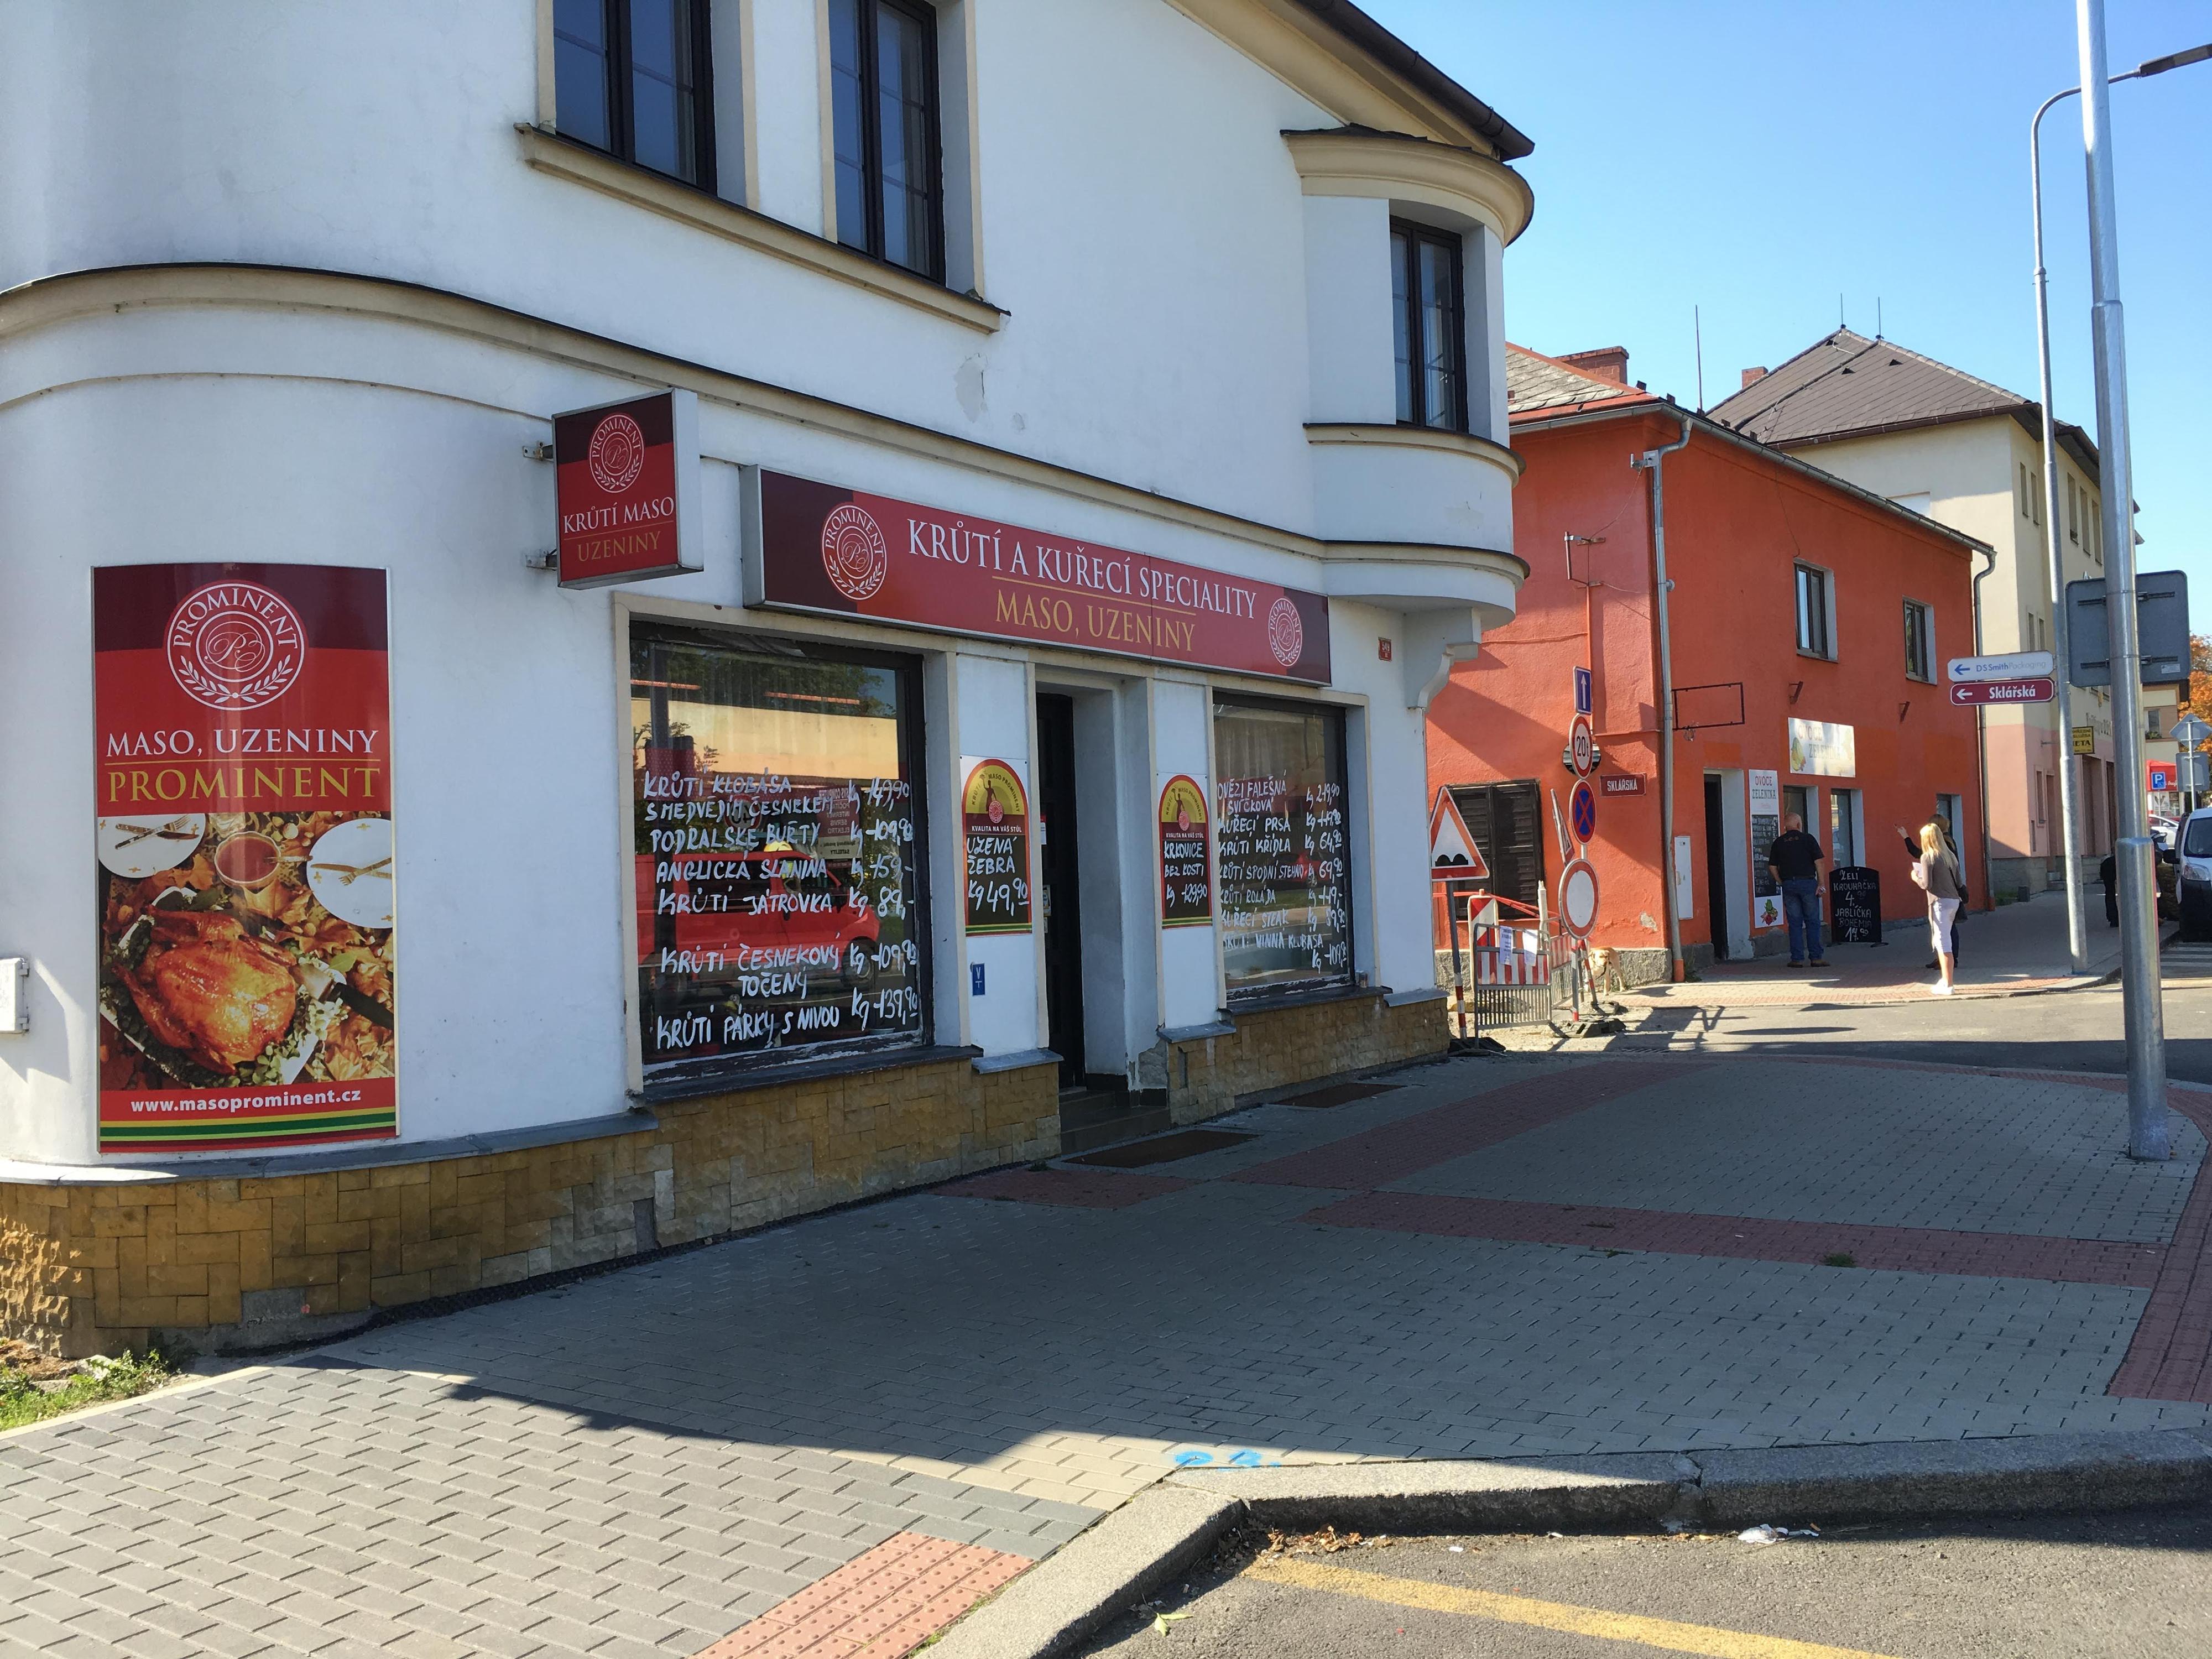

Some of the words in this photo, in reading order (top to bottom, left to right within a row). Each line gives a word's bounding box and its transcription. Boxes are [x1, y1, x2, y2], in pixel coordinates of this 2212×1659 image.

[592, 418, 641, 457] PROMINENT
[563, 502, 618, 533] KRŮTÍ
[624, 497, 674, 524] MASO
[577, 531, 661, 561] UZENINY
[826, 509, 884, 557] PROMINENT
[907, 520, 1001, 571] KRŮTÍ
[1009, 541, 1030, 576] A
[1036, 545, 1132, 594] KUŘECÍ
[1140, 567, 1256, 619] SPECIALITY
[173, 588, 298, 649] PROMINENT
[996, 589, 1079, 638] MASO,
[1088, 605, 1195, 651] UZENINY
[1270, 601, 1301, 635] PROMINENT
[1989, 685, 2036, 699] Sklářská
[107, 729, 202, 757] MASO,
[213, 729, 379, 753] UZENINY
[1798, 724, 1822, 741] OVOCE
[108, 767, 380, 802] PROMINENT
[644, 764, 707, 799] KRŮTÍ
[713, 767, 791, 794] KLOBÁSA
[1218, 774, 1245, 800] OVĚZÍ
[1607, 778, 1637, 791] SKLÁŘSKÁ
[1752, 789, 1776, 799] ZELENINA
[1755, 776, 1772, 786] OVOCE
[644, 802, 658, 821] S
[749, 796, 833, 817] ČESNEKEM
[1265, 816, 1291, 832] PRSA
[967, 837, 1017, 855] UZENÁ
[1164, 841, 1204, 859] KRKOVICE
[1256, 833, 1291, 857] KŘÍDLA
[1319, 830, 1342, 853] 64,90
[656, 850, 751, 884] ANGLICKÁ
[759, 858, 828, 880] SLANINA
[967, 855, 1015, 875] ŽEBRA
[1165, 864, 1180, 878] BEZ
[1183, 864, 1204, 877] KOSTI
[1246, 860, 1278, 884] SPODNÍ
[1279, 864, 1304, 879] STEHNO
[1319, 857, 1343, 884] 69,90
[1840, 868, 1859, 880] ŽELÍ
[658, 885, 733, 915] KRŮTÍ
[743, 888, 832, 916] JÁTROVKA
[987, 877, 1030, 916] 49,90
[1246, 885, 1276, 905] ROLÁDA
[1262, 908, 1289, 928] STEAK
[1835, 905, 1871, 918] JABLÍČKA
[661, 943, 727, 973] KRŮTÍ
[738, 932, 839, 972] ČESNEKOVÝ
[738, 966, 807, 999] TOČENÝ
[657, 1004, 714, 1050] KRŮTÍ
[724, 1003, 774, 1048] PÁRKY
[781, 1011, 794, 1035] S
[797, 1006, 839, 1031] NIVOU
[131, 1089, 361, 1113] www.masoprominent.cz
